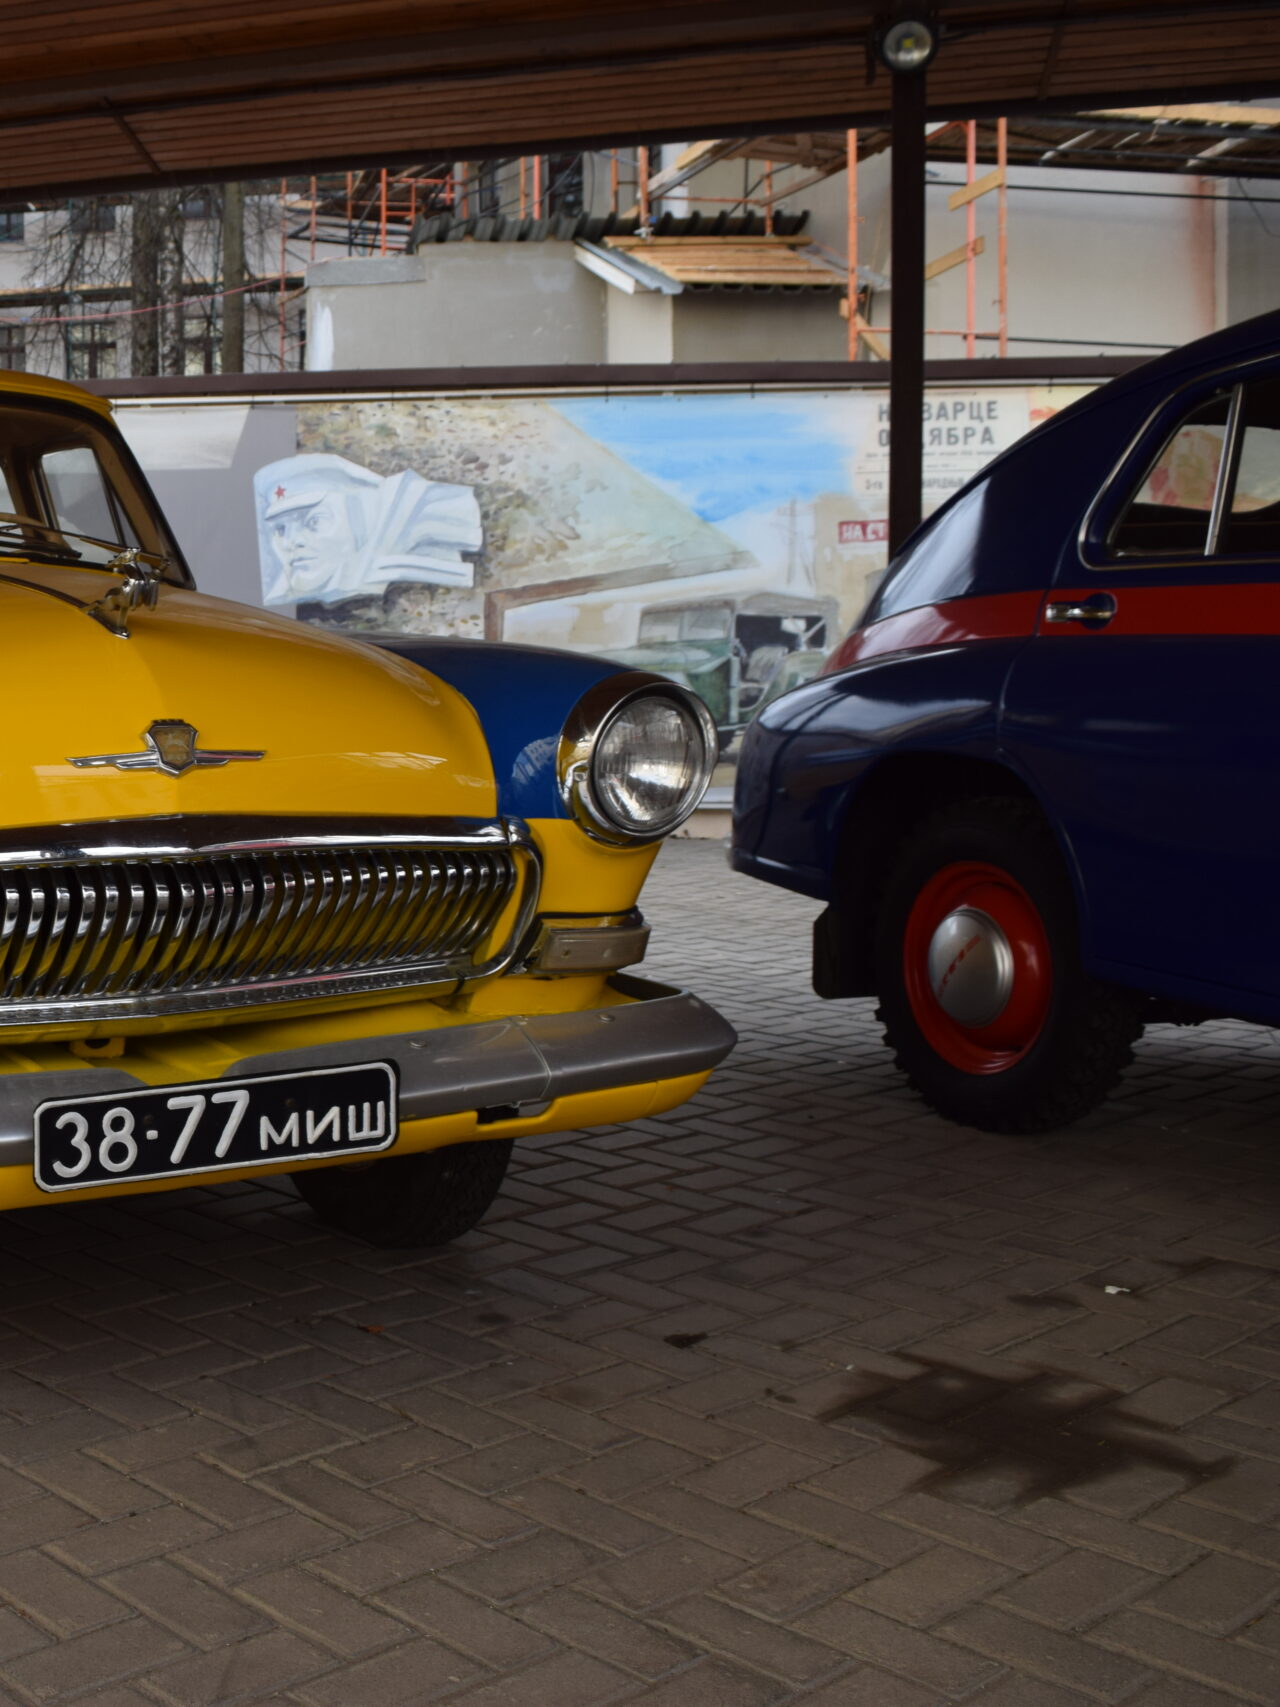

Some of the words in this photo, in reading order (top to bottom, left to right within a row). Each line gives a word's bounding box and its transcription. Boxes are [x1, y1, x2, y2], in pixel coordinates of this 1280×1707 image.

[878, 426, 995, 448] ОЯБРА
[865, 522, 887, 540] СТ
[52, 1089, 251, 1179] 38-77
[260, 1101, 386, 1150] МИШ
